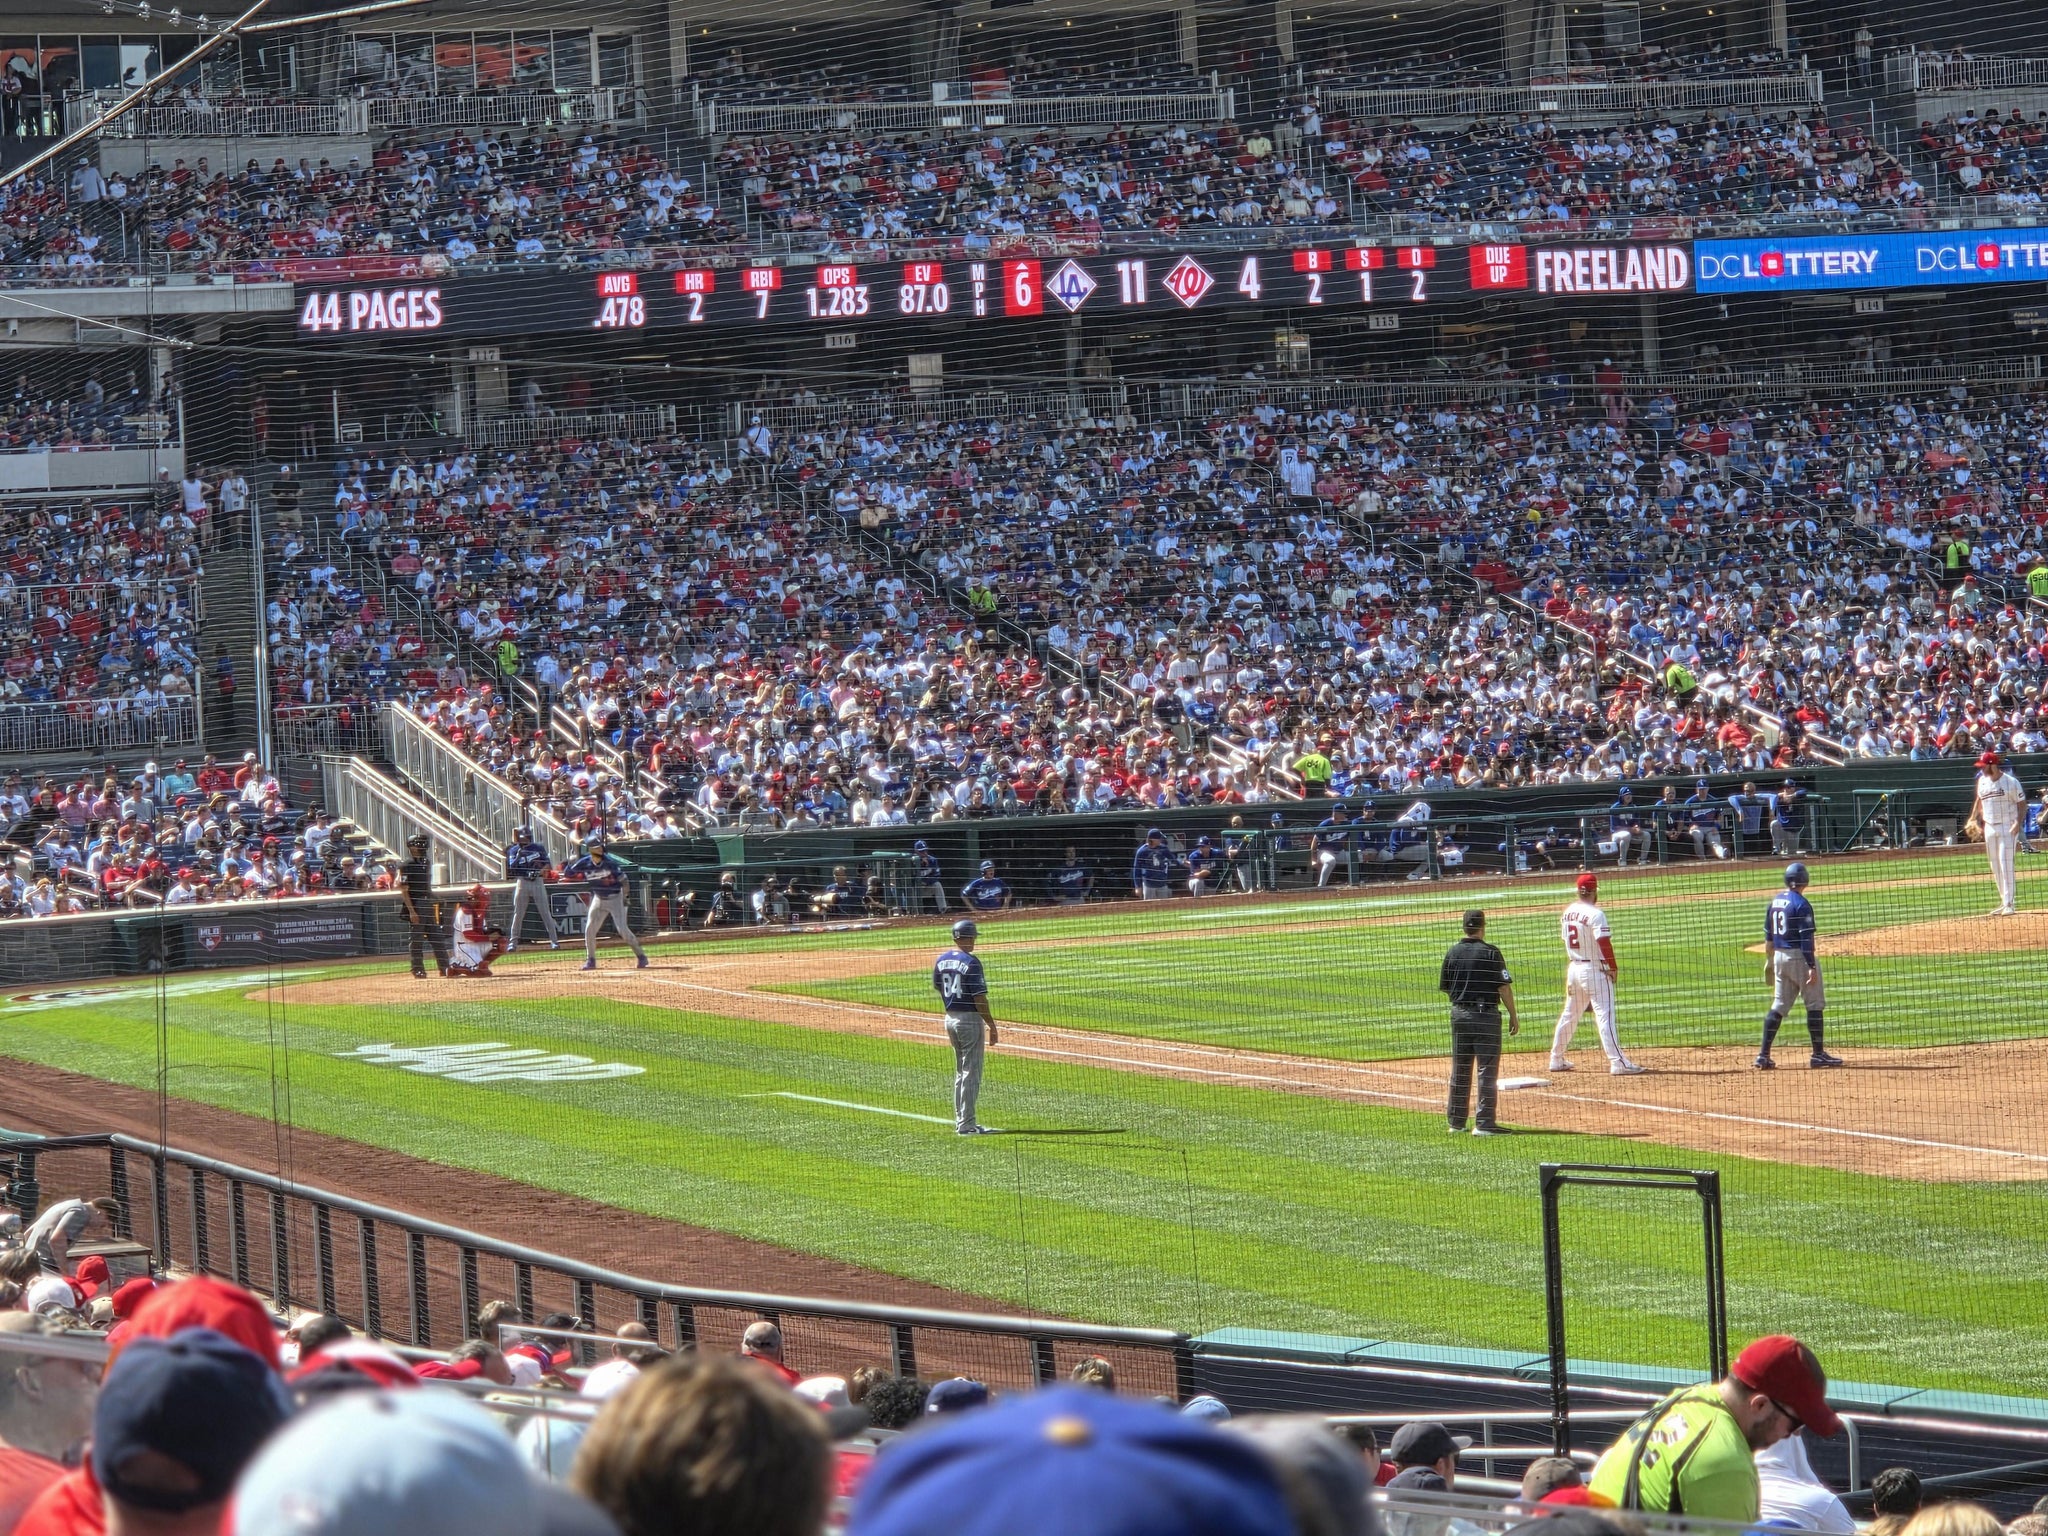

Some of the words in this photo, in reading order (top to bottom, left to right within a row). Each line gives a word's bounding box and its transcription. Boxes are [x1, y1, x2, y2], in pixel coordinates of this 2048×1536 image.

[1308, 251, 1318, 269] B
[1360, 250, 1369, 267] S
[1411, 248, 1421, 266] O
[1486, 247, 1510, 264] DUE
[684, 273, 704, 290] HR
[750, 271, 773, 288] RBI
[823, 268, 850, 285] OPS
[915, 265, 931, 281] EV
[1118, 261, 1146, 303] 11
[1239, 257, 1260, 300] 4
[1490, 265, 1508, 283] UP
[1536, 247, 1689, 293] FREELAND
[604, 275, 630, 293] AVG
[1015, 272, 1032, 307] 6
[1308, 273, 1322, 303] 2
[1360, 271, 1371, 302] 1
[1412, 270, 1426, 300] 2
[302, 293, 342, 331] 44
[350, 290, 442, 330] PAGES
[689, 292, 703, 321] 2
[756, 289, 769, 319] 7
[806, 286, 868, 317] 1.283
[900, 283, 948, 313] 87.0
[594, 296, 645, 327] .478
[1375, 316, 1395, 328] 115
[1772, 911, 1786, 935] 13
[1568, 925, 1580, 949] 2
[942, 973, 963, 999] 84
